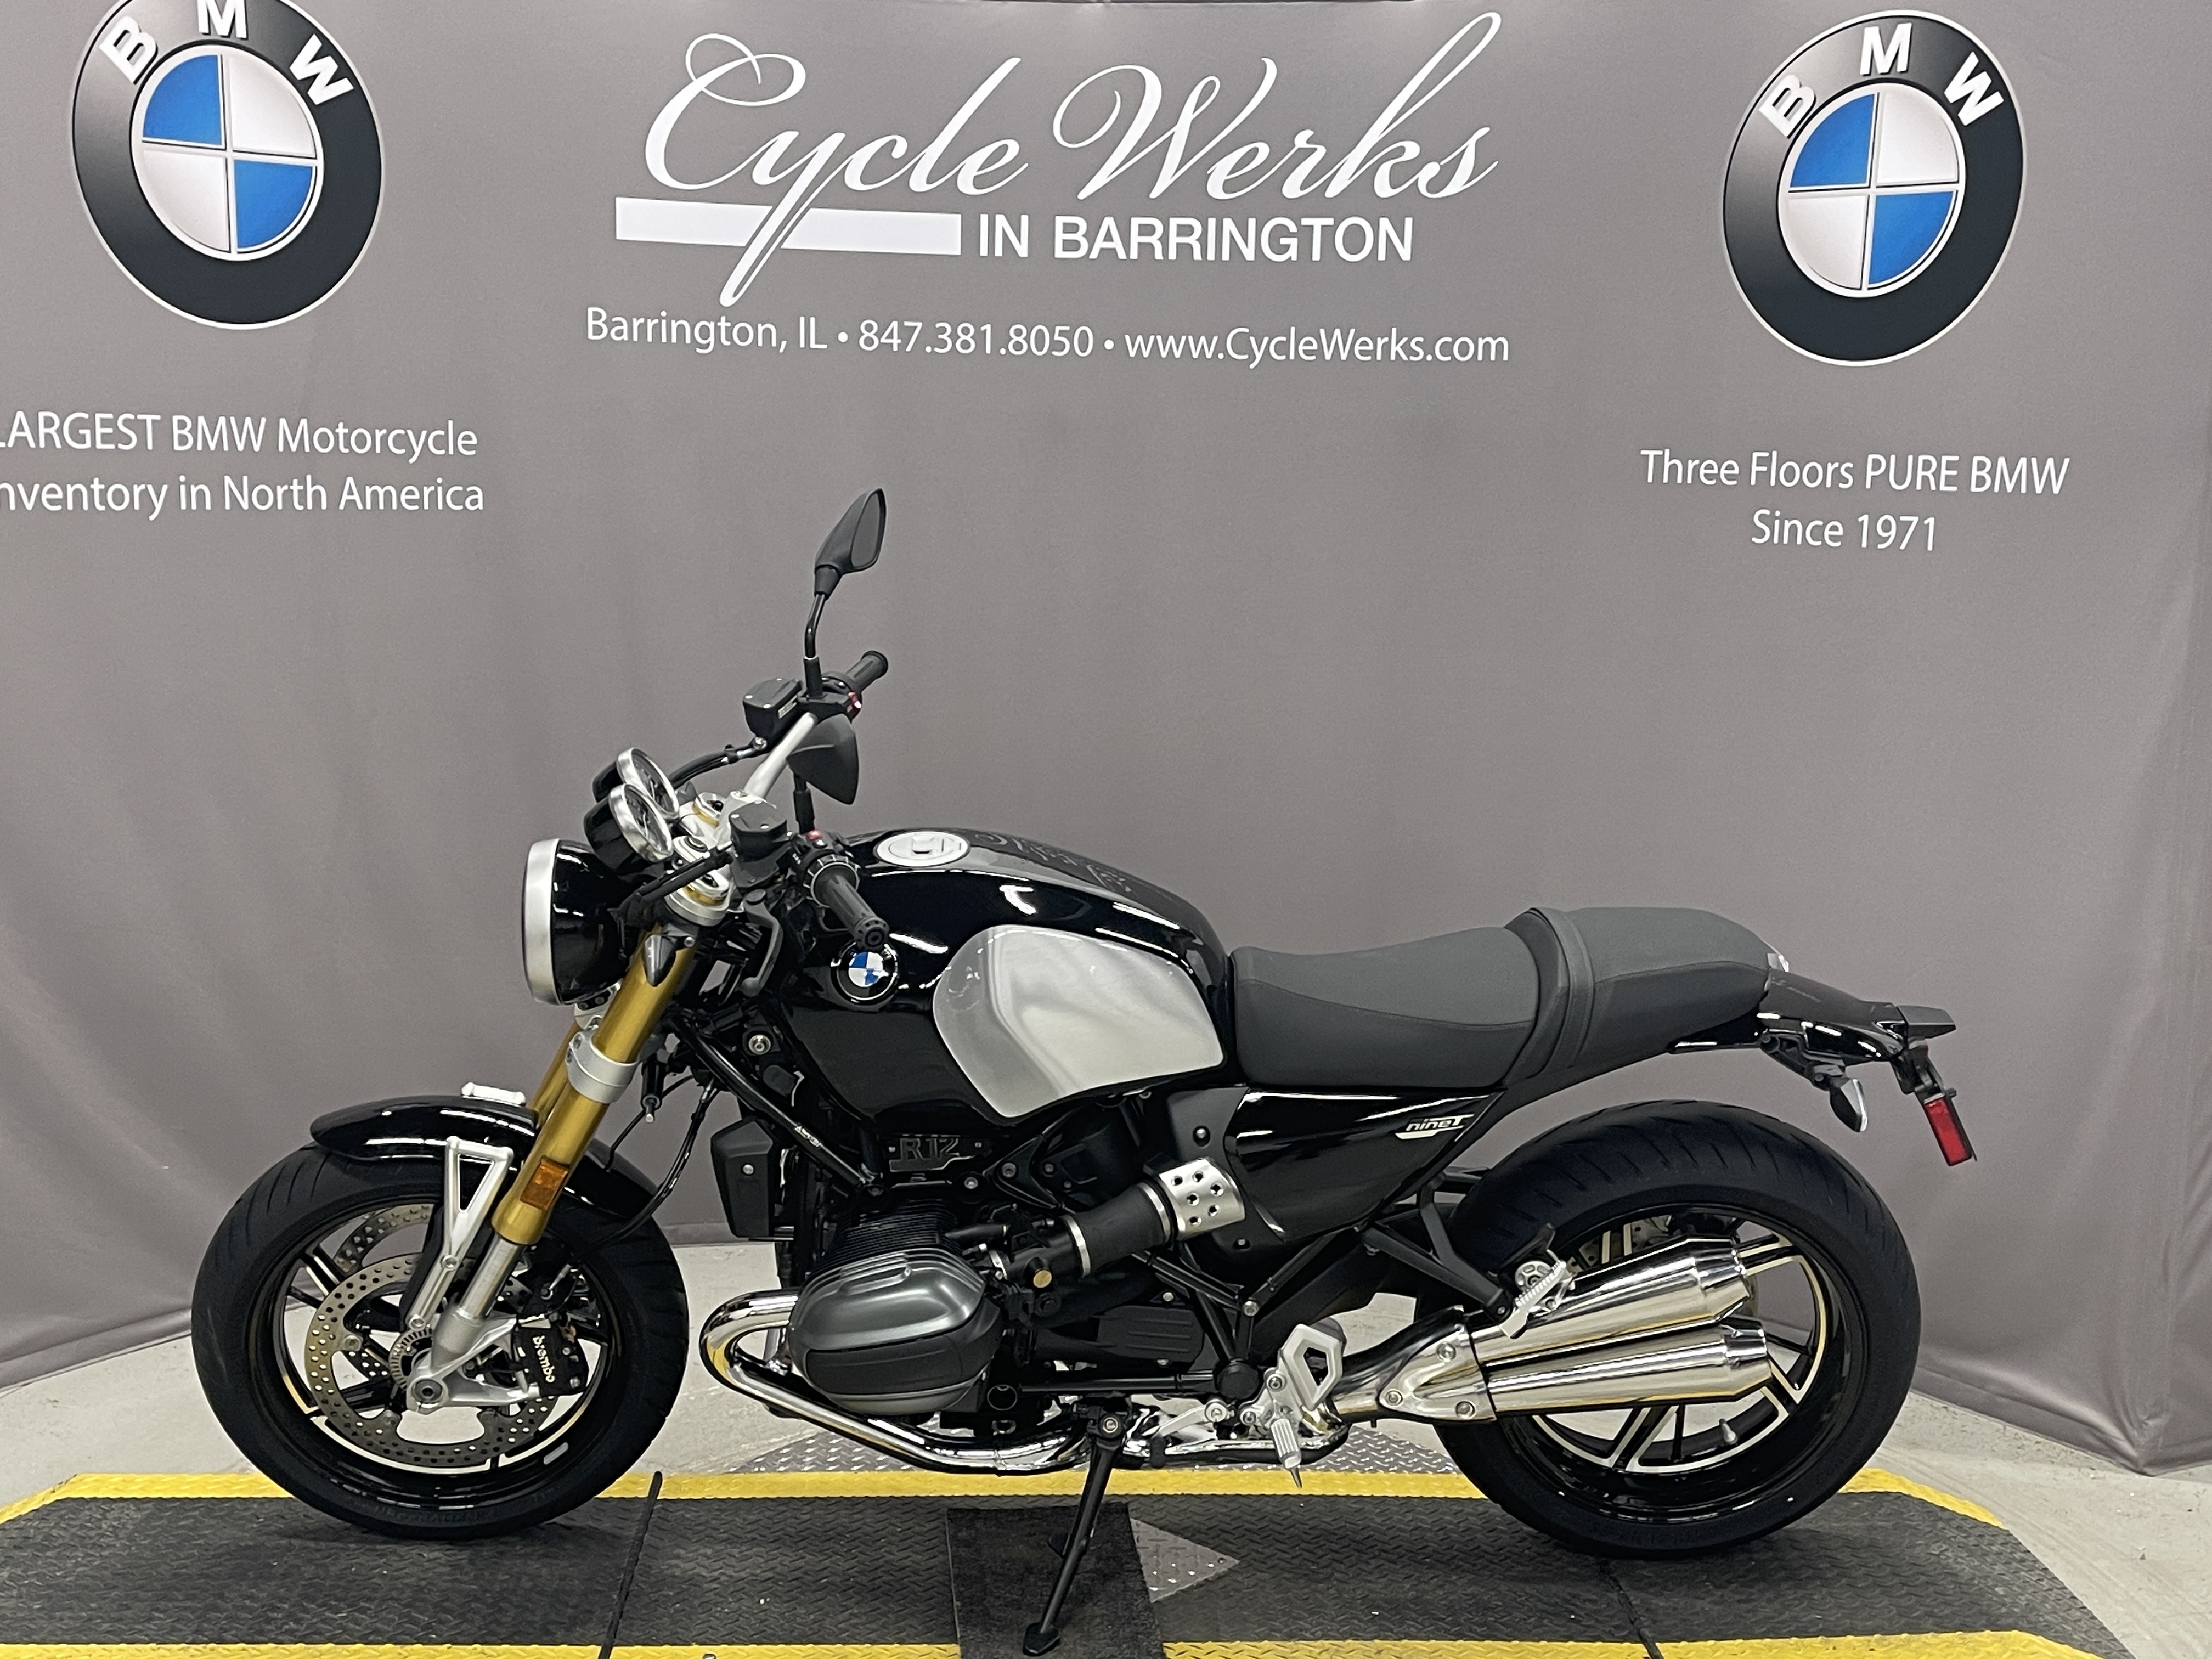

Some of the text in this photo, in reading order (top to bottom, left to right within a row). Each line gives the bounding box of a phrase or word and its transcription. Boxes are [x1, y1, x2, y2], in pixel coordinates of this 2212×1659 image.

[99, 0, 354, 105] BMW
[1759, 23, 2004, 137] BMW
[645, 12, 1501, 307] Cycle Werks
[979, 213, 1413, 262] IN BARRINGTON
[588, 307, 1509, 369] Barrington, IL 847.381.8050 www.CycleWerks.com
[172, 415, 267, 452] BMW
[278, 417, 478, 464] Motorcycle
[179, 475, 211, 510] in
[223, 474, 327, 510] North
[338, 476, 483, 511] America
[1640, 448, 2070, 494] Three Floors PURE BMW
[1751, 509, 1936, 551] Since 1971
[532, 1335, 555, 1383] brembo
